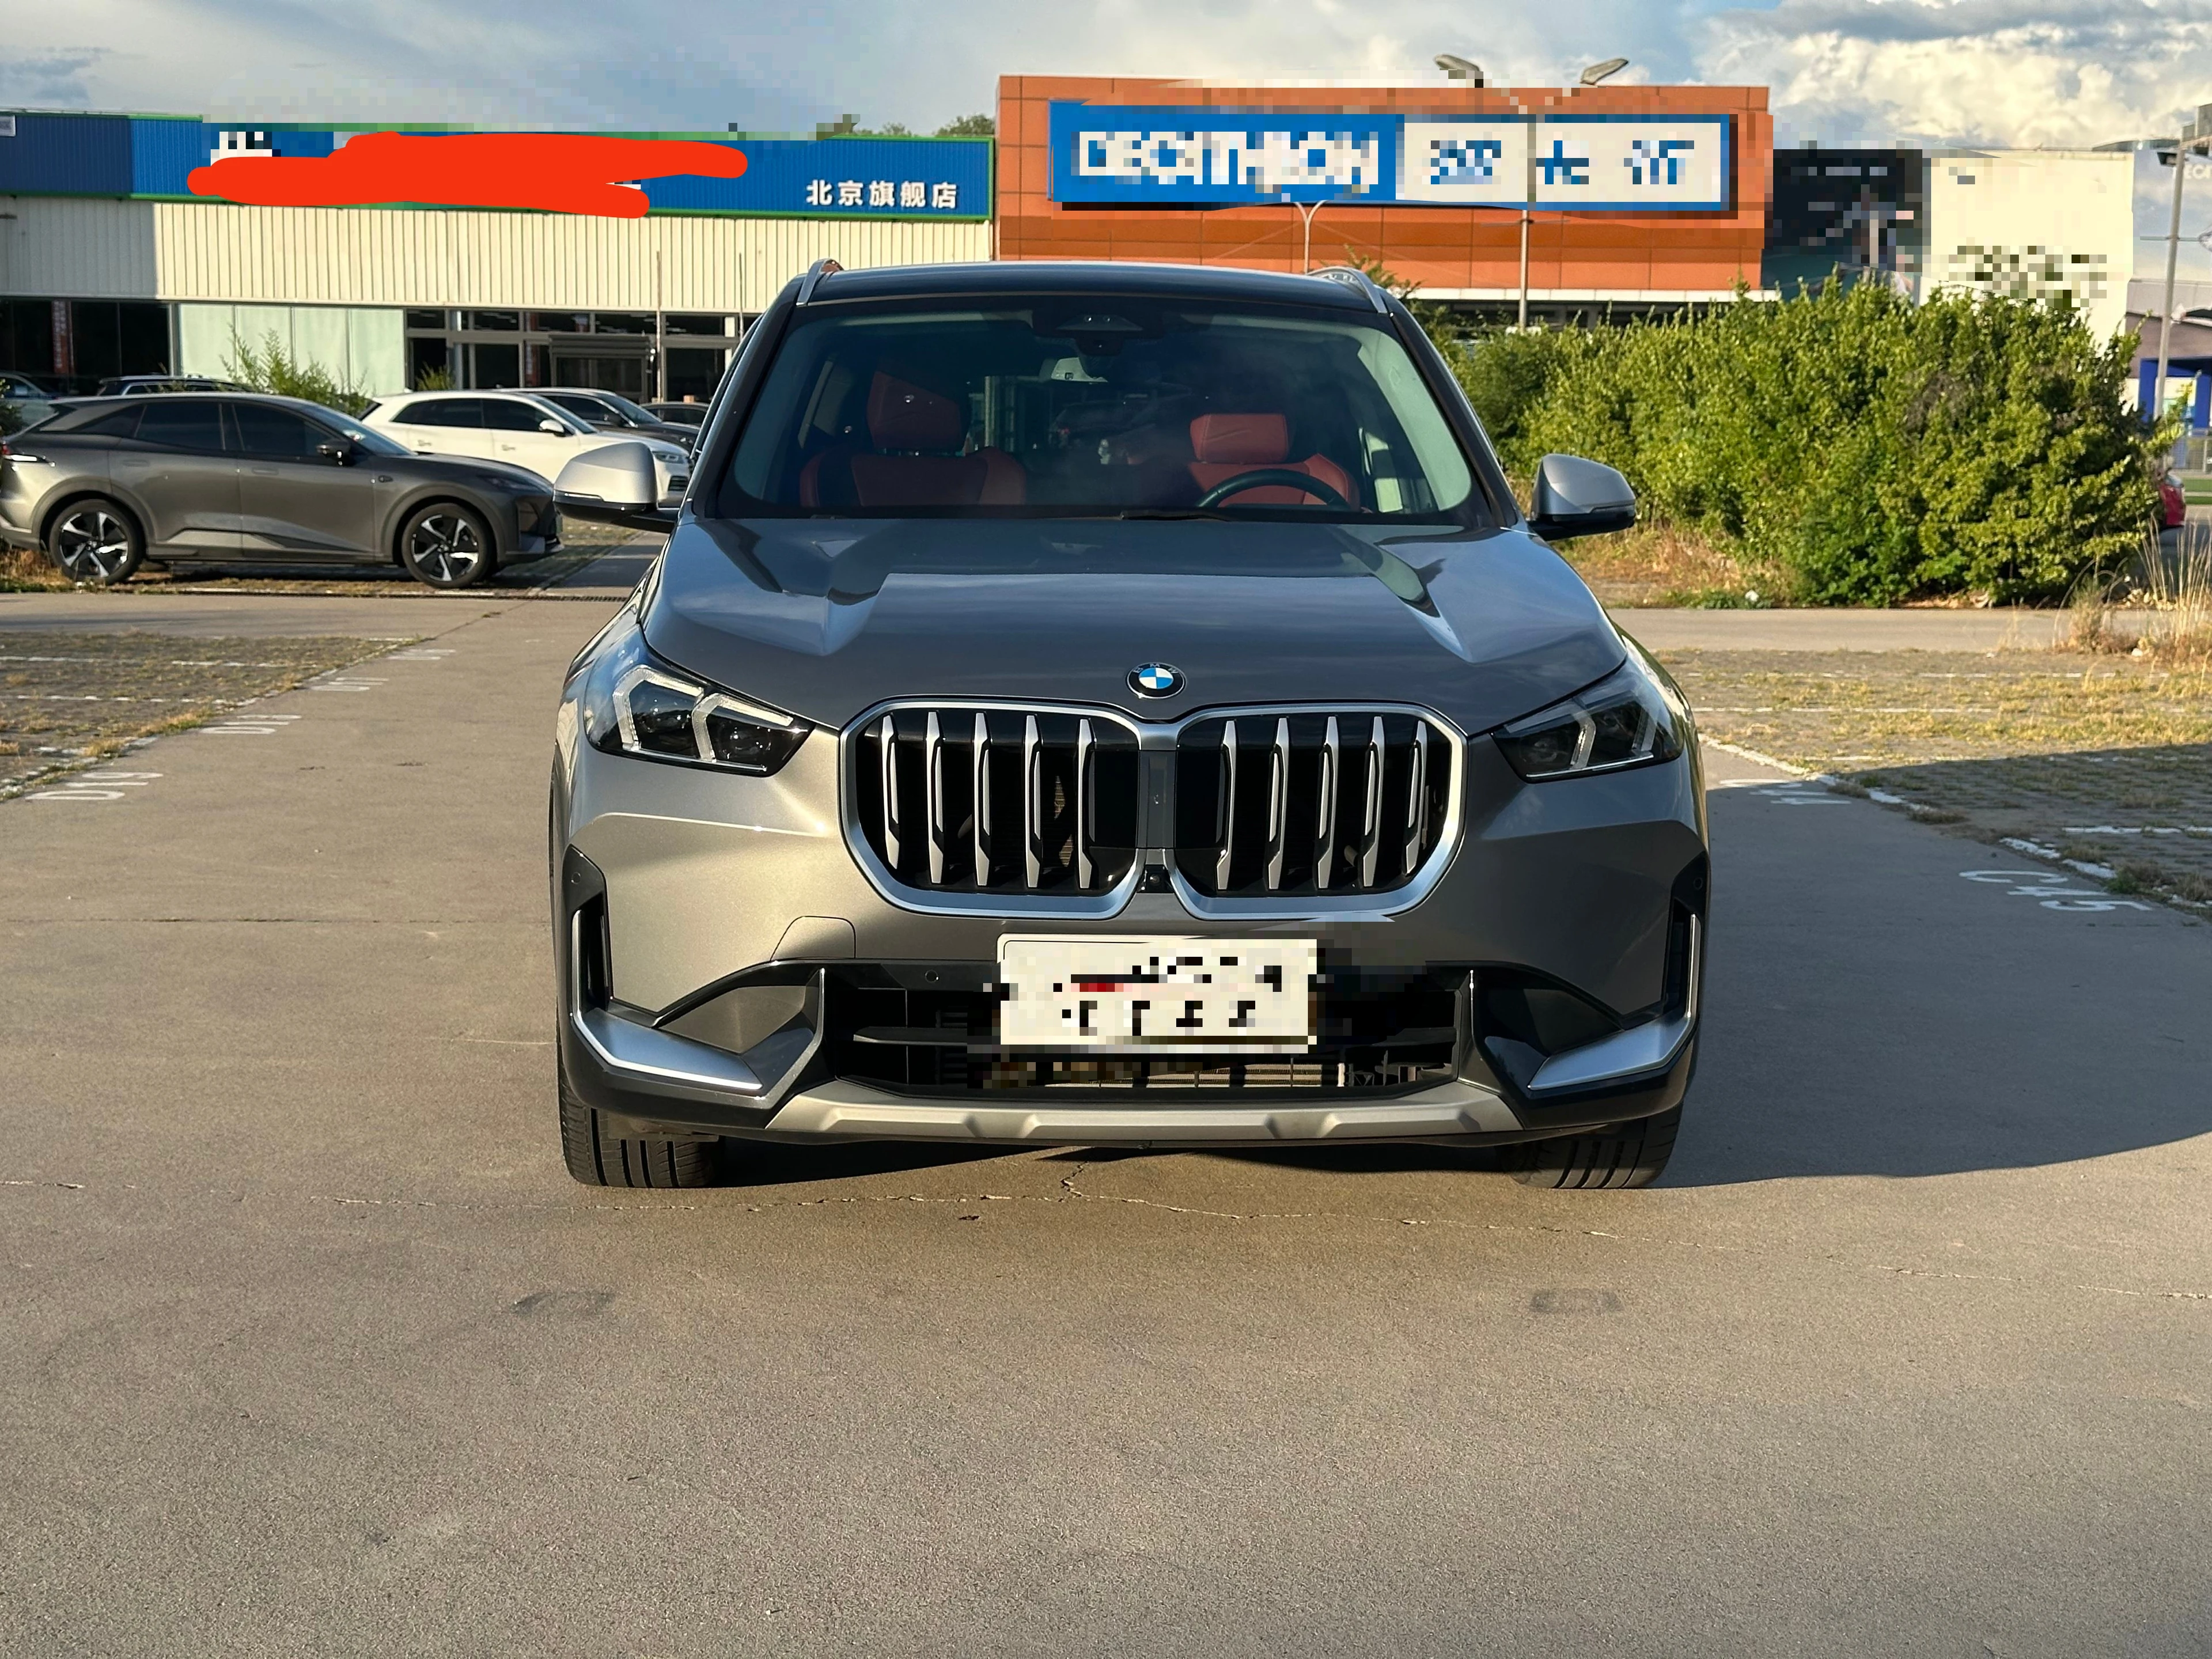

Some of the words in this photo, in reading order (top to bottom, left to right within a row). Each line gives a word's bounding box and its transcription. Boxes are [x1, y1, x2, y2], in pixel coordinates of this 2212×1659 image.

[806, 179, 957, 209] 北京旗舰店
[1959, 870, 2153, 912] C45
